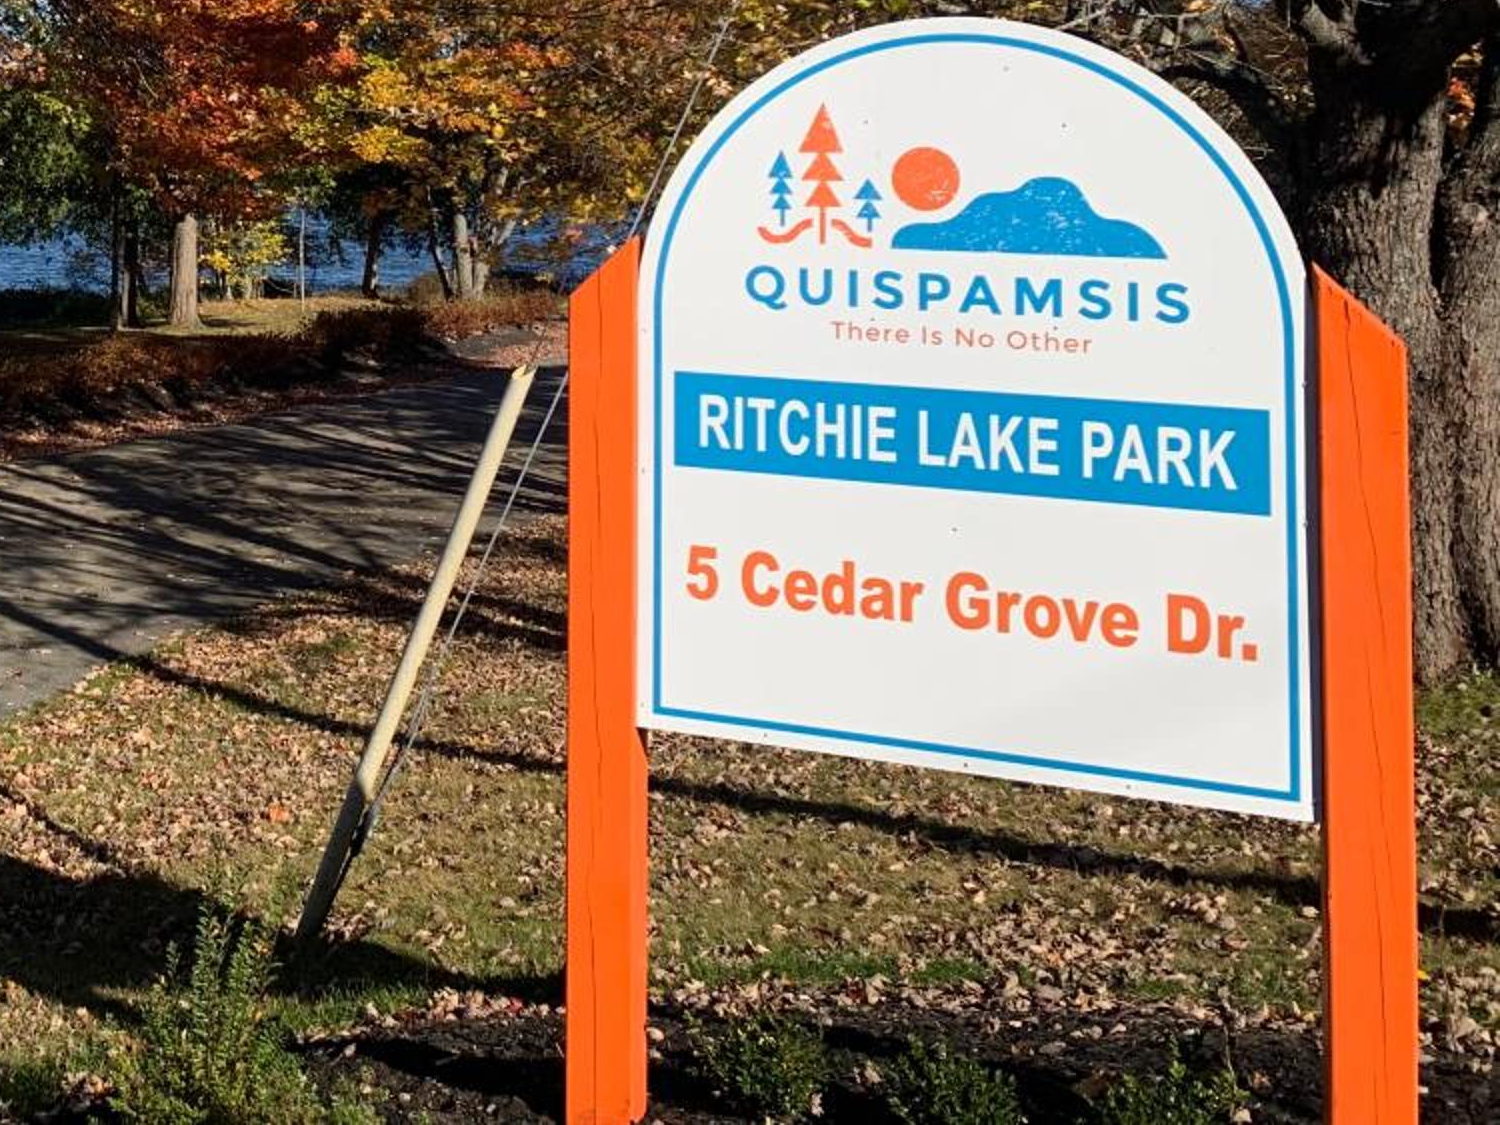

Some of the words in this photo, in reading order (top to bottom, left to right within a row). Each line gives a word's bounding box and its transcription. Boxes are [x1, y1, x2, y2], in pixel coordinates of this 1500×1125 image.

[745, 264, 1191, 324] QUISPAMSIS
[831, 321, 913, 344] There
[922, 326, 943, 346] Is
[954, 328, 996, 349] No
[1007, 330, 1092, 354] Other
[698, 395, 897, 463] RITCHIE
[918, 411, 1059, 476] LAKE
[1082, 421, 1238, 489] PARK
[685, 546, 718, 600] 5
[741, 551, 924, 622] Cedar
[946, 572, 1139, 647] Grove
[1167, 594, 1258, 661] Dr.
